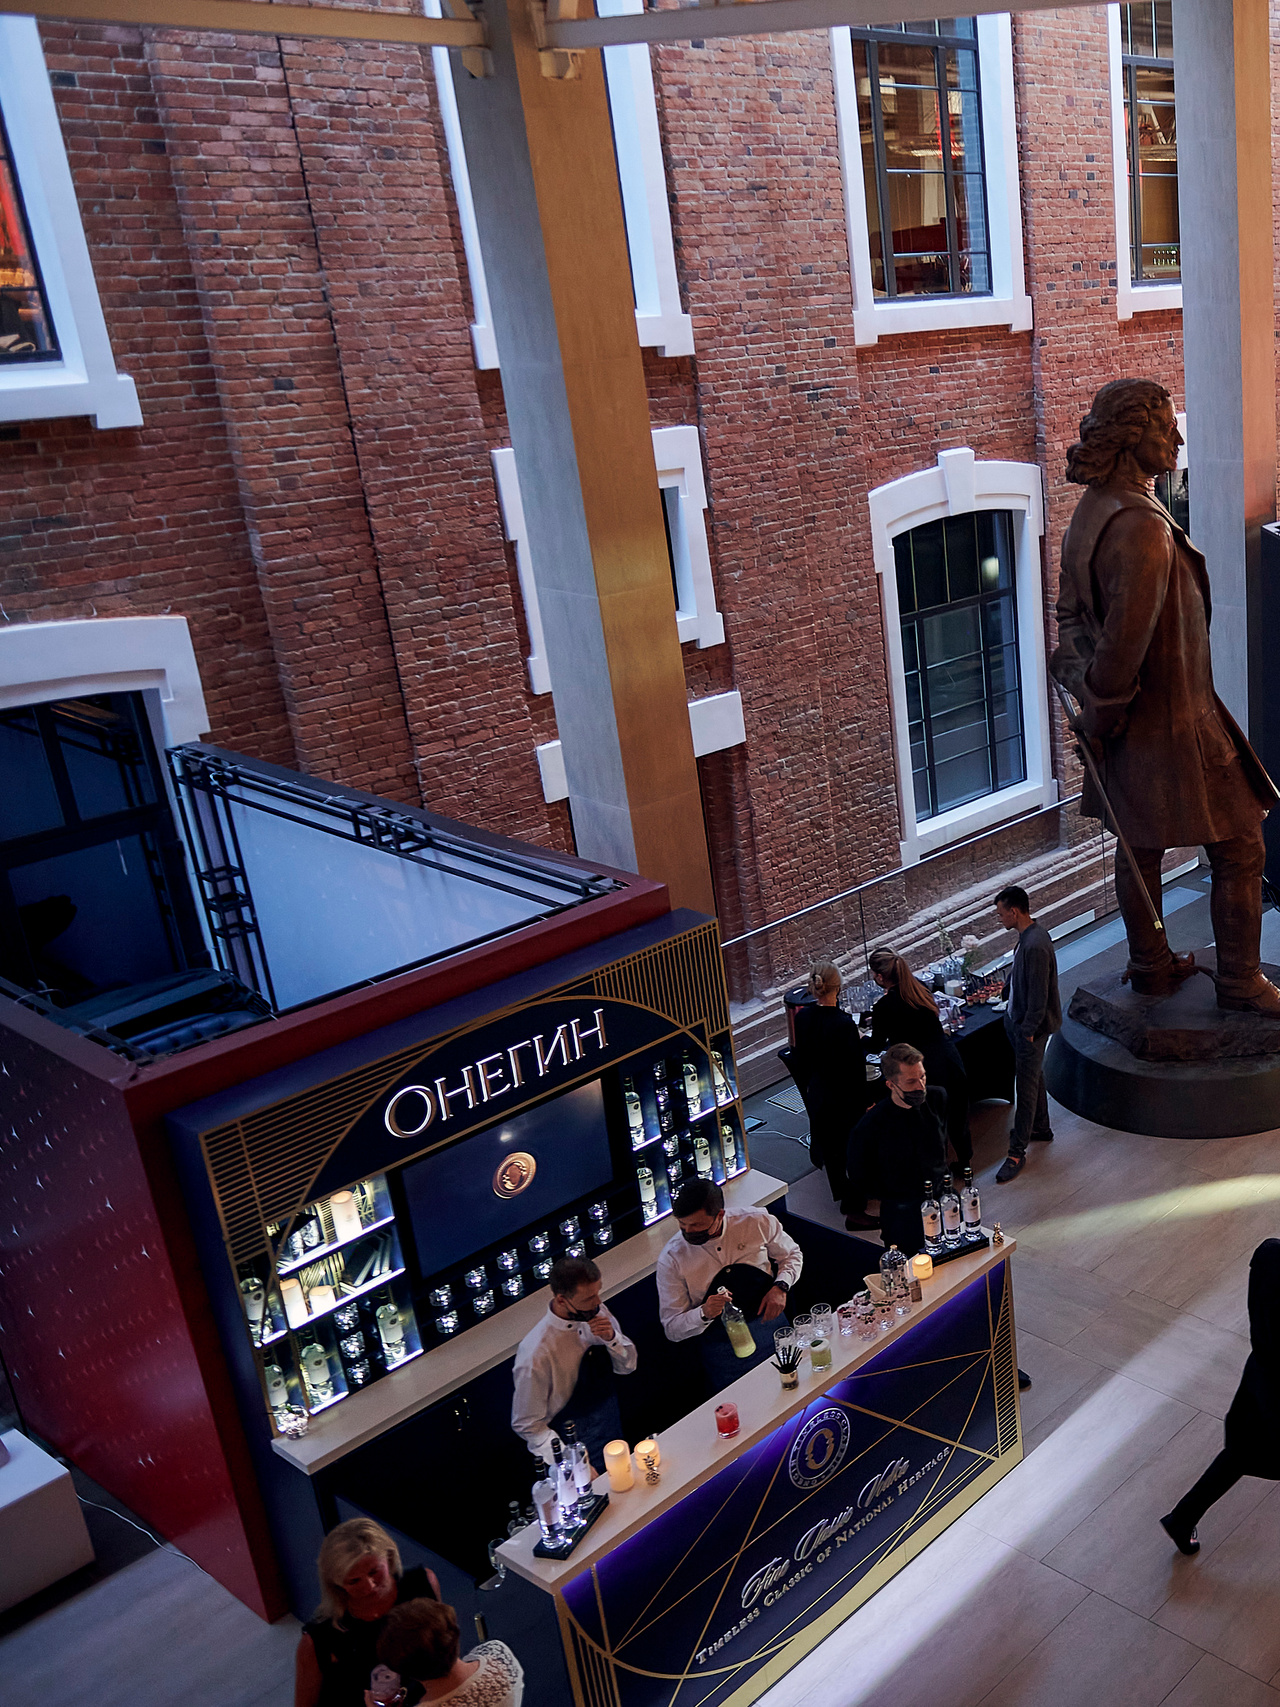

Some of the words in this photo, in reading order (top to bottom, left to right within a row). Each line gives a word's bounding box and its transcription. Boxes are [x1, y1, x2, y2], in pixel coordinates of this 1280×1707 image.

[384, 1008, 609, 1139] ОНЕГИН
[695, 1607, 760, 1665] TIMELESS
[763, 1562, 814, 1607] CLASSIC
[816, 1546, 833, 1563] OF
[834, 1495, 895, 1548] NATIONAL
[897, 1446, 950, 1496] HERITAGE
[741, 1556, 791, 1609] Fine
